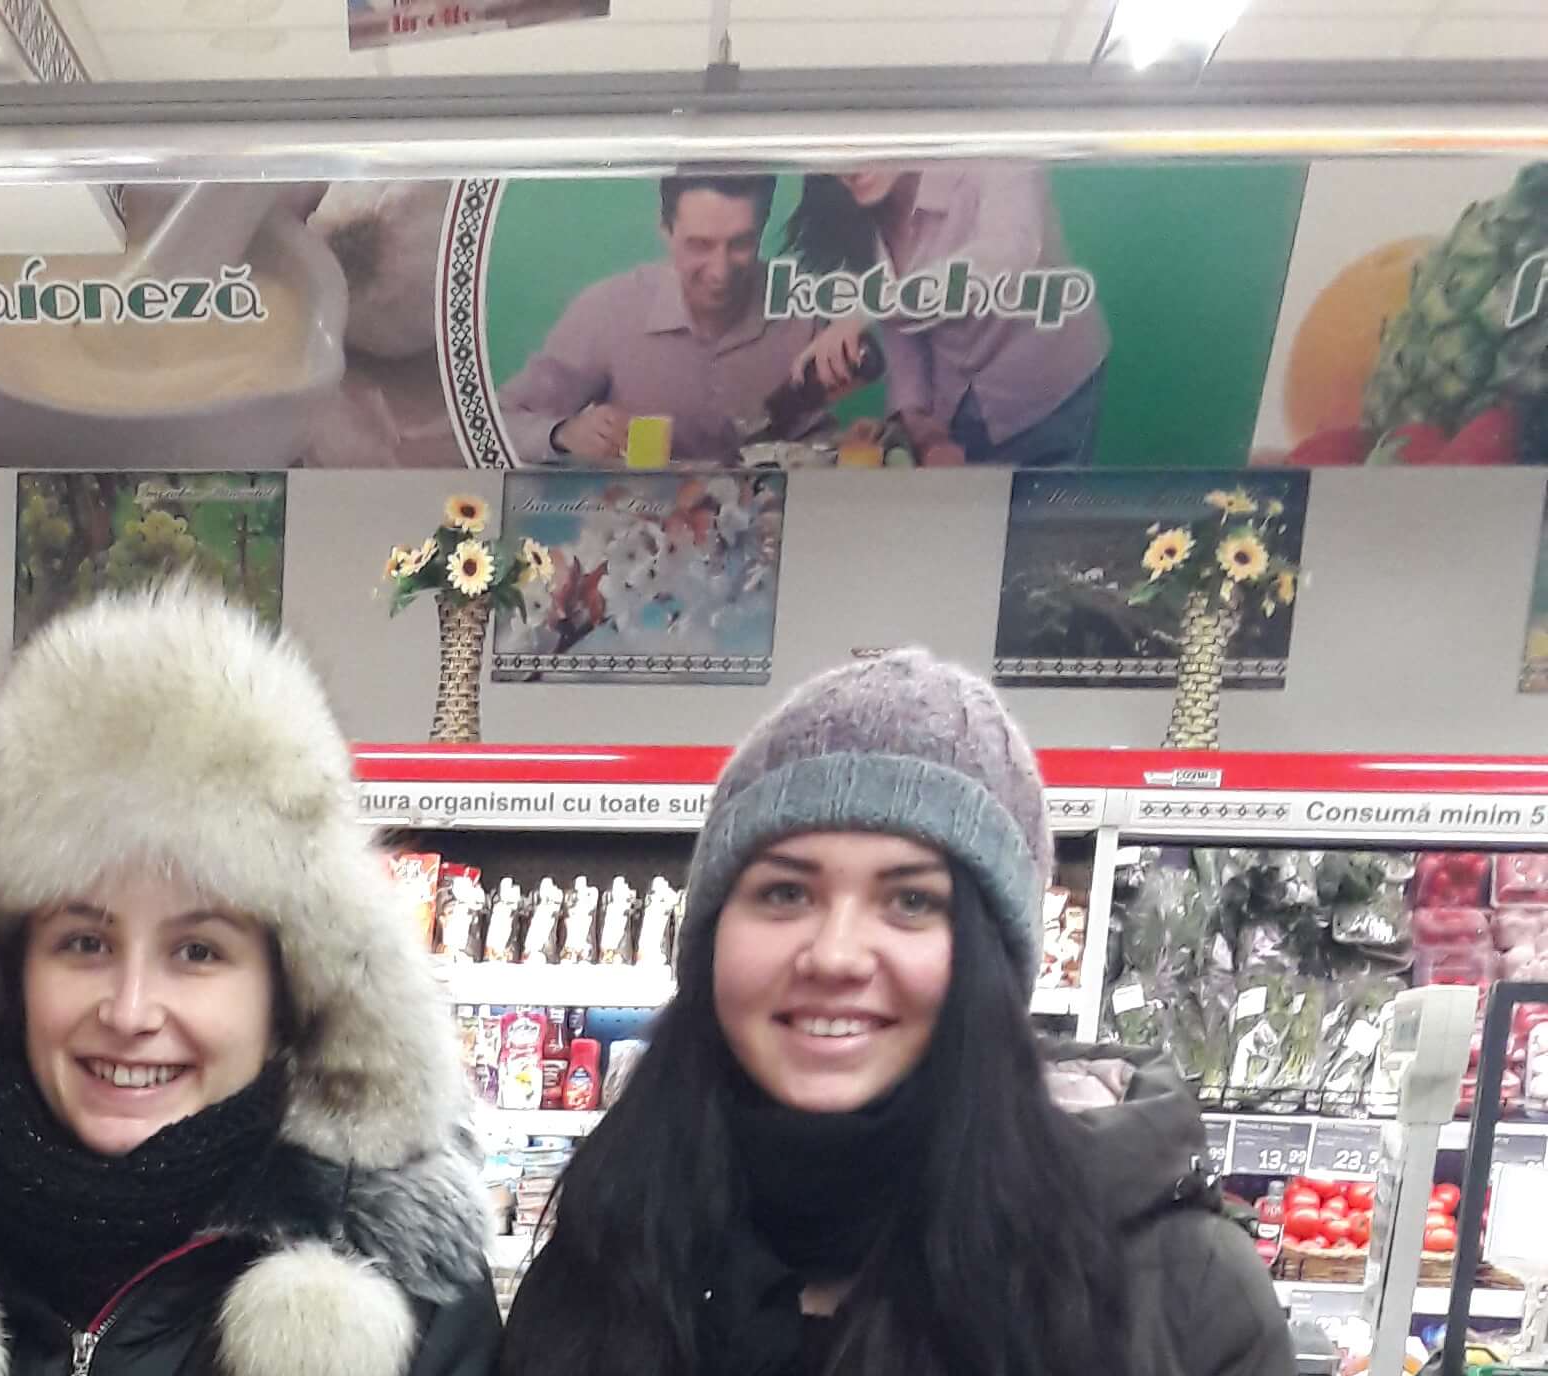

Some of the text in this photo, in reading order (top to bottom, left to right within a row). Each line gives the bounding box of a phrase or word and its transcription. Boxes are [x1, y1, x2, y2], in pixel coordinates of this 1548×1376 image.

[764, 257, 1095, 329] ketchup
[418, 791, 555, 815] organismul
[563, 795, 592, 814] cu
[601, 793, 661, 814] toate
[669, 793, 714, 815] sub
[1305, 799, 1432, 826] Consumă
[1438, 802, 1523, 827] minim
[1332, 1149, 1383, 1175] 23,9
